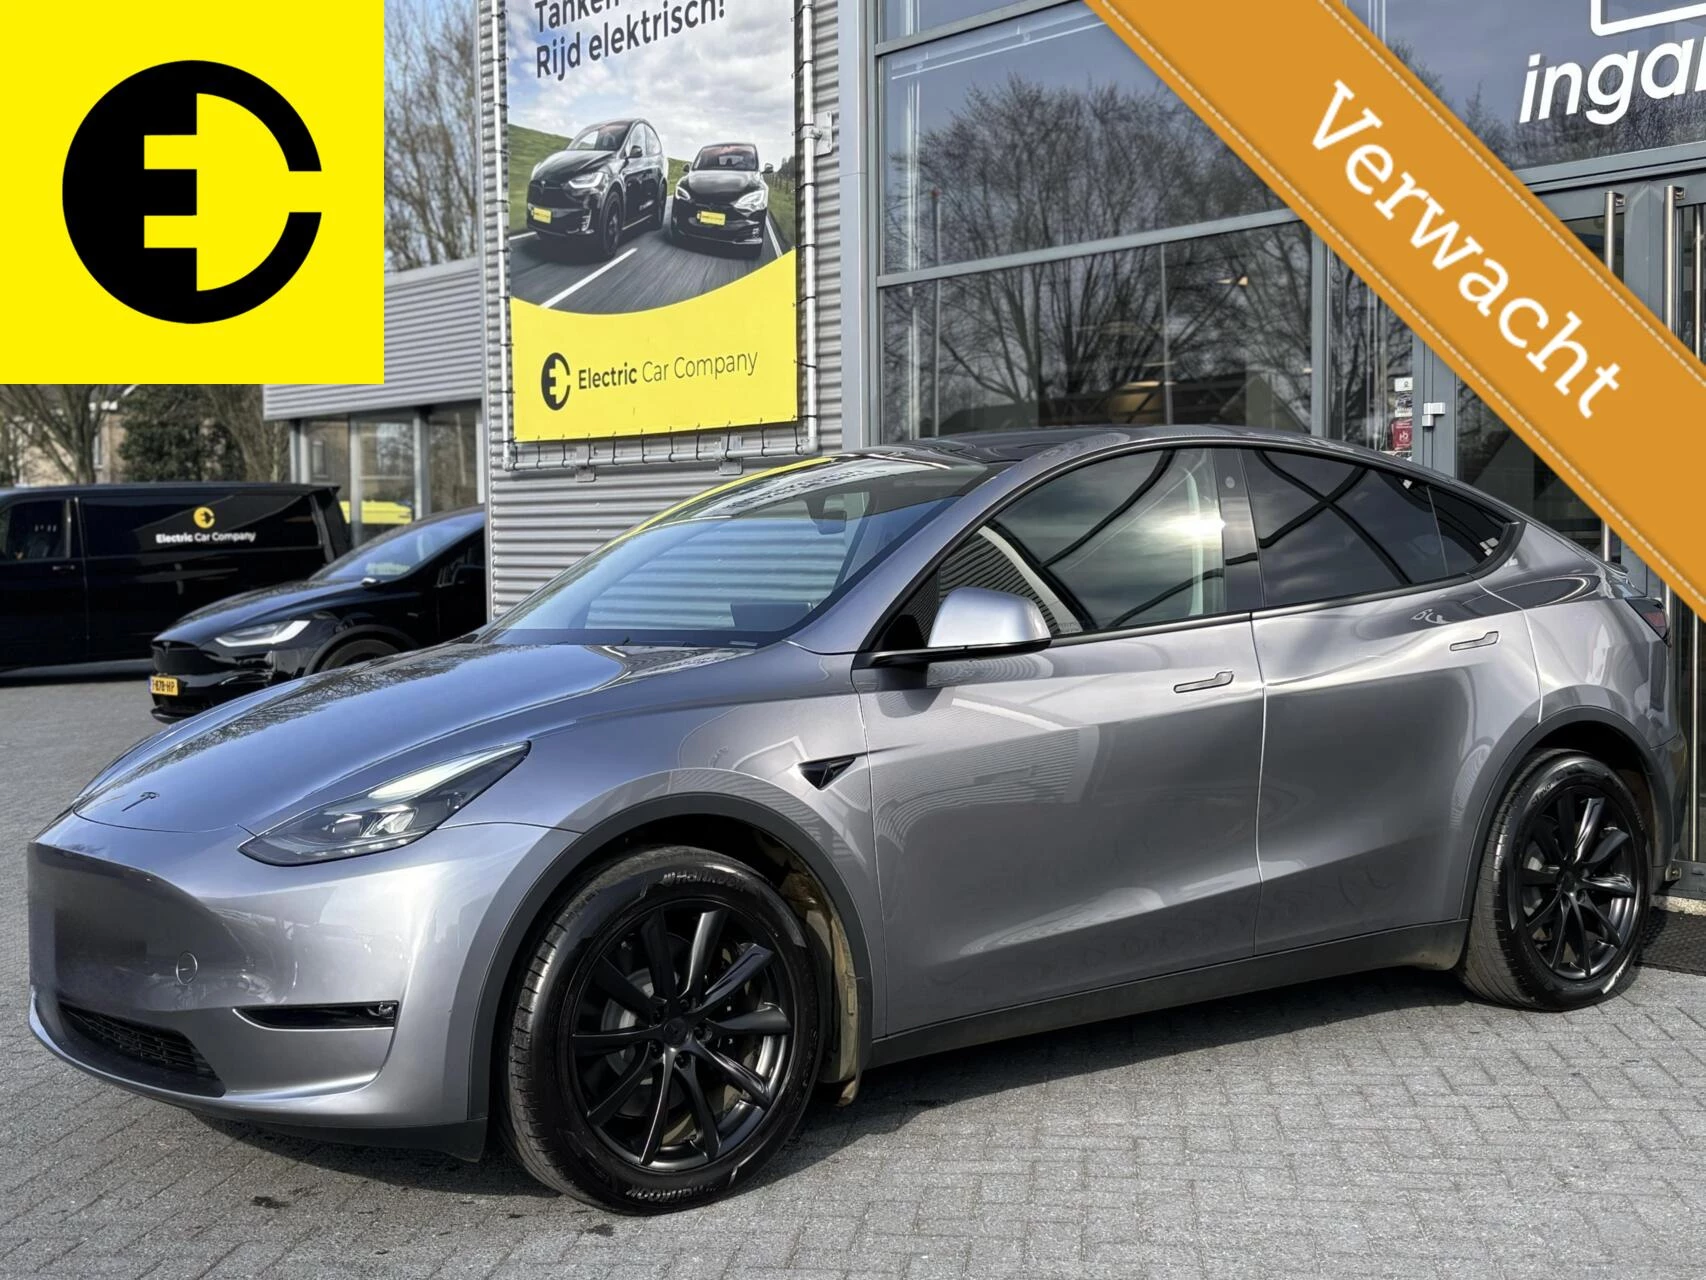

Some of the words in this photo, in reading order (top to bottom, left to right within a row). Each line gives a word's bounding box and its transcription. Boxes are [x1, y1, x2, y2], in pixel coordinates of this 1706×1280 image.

[536, 31, 581, 82] Rijd
[588, 0, 725, 62] elektrisch!
[1519, 36, 1706, 126] inga
[578, 361, 638, 390] Electric
[642, 360, 669, 384] Car
[673, 351, 759, 380] Company
[155, 532, 194, 544] Electric
[194, 532, 211, 543] Car
[211, 531, 257, 543] Company
